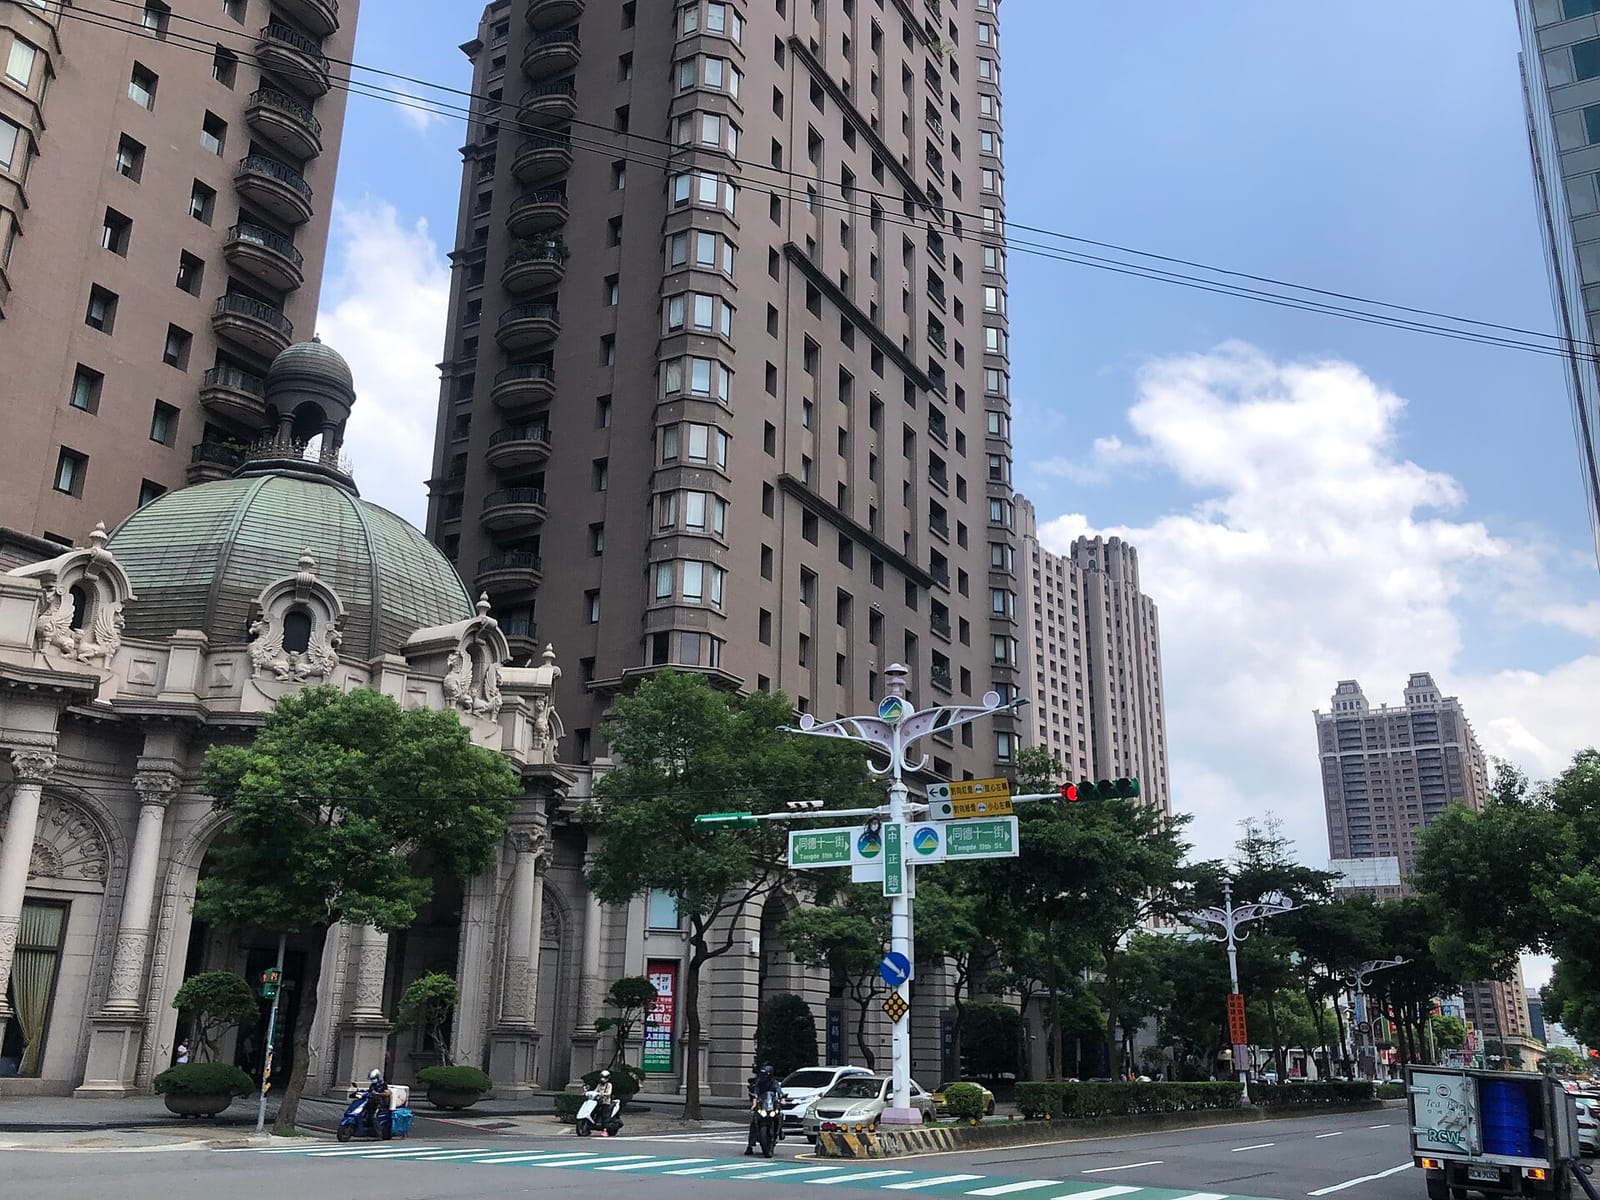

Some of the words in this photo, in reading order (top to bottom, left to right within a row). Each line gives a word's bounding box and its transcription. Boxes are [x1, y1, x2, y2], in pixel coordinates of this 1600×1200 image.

[952, 825, 1004, 841] 同德十一街
[799, 835, 845, 850] 同德十一街
[888, 831, 899, 887] 中正路
